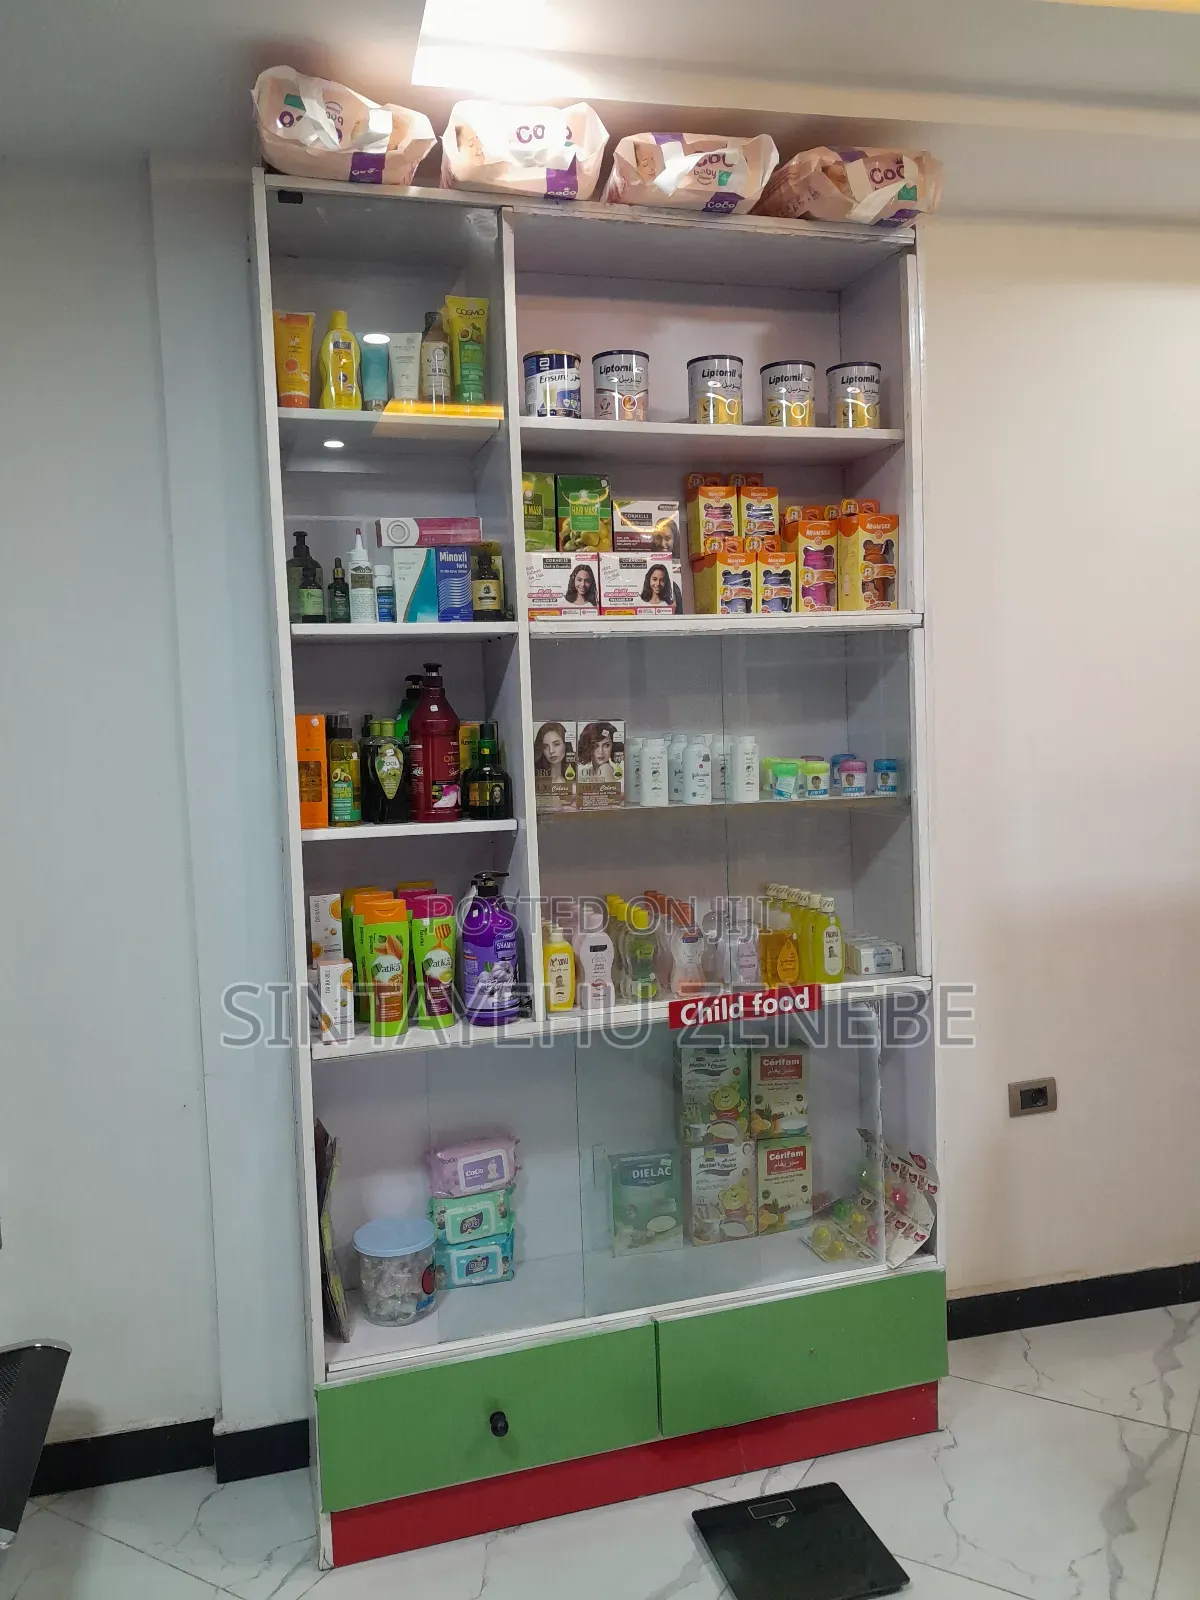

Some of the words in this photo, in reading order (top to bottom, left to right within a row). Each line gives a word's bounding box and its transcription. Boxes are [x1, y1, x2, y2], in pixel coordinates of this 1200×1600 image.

[455, 307, 486, 317] COSMO
[539, 374, 569, 384] Ensure
[701, 368, 737, 379] Liptomil
[768, 373, 803, 385] Liptomil
[841, 374, 875, 385] Liptomil
[571, 505, 584, 516] HAIR
[439, 551, 468, 562] Minoxil
[375, 962, 401, 973] Vatika
[425, 957, 451, 968] Vatika
[680, 997, 744, 1026] Child
[752, 986, 810, 1017] food
[762, 1058, 800, 1067] Cérifam
[768, 1150, 804, 1161] Cérifam
[632, 1167, 672, 1180] DIELAC
